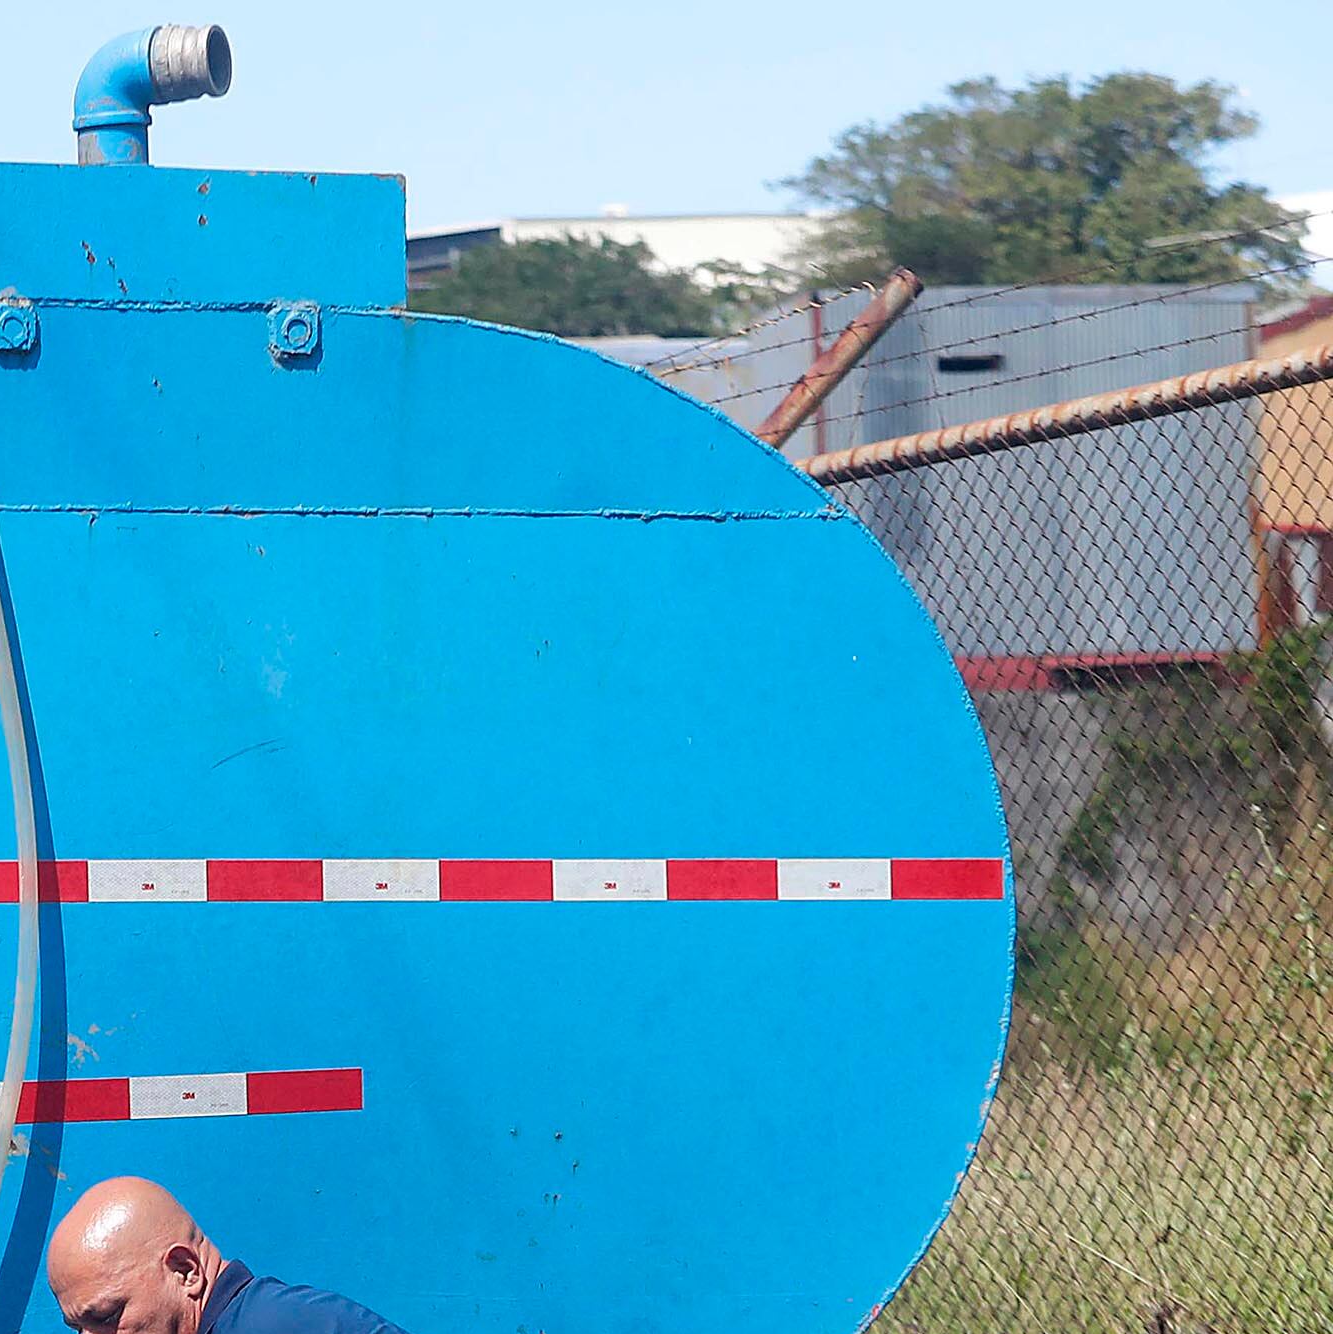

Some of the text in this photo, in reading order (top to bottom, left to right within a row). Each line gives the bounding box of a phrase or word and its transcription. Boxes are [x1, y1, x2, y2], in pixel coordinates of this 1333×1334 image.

[141, 882, 155, 890] 3M
[604, 881, 617, 889] 3M
[828, 881, 841, 889] 3M
[182, 1092, 196, 1100] 3M
